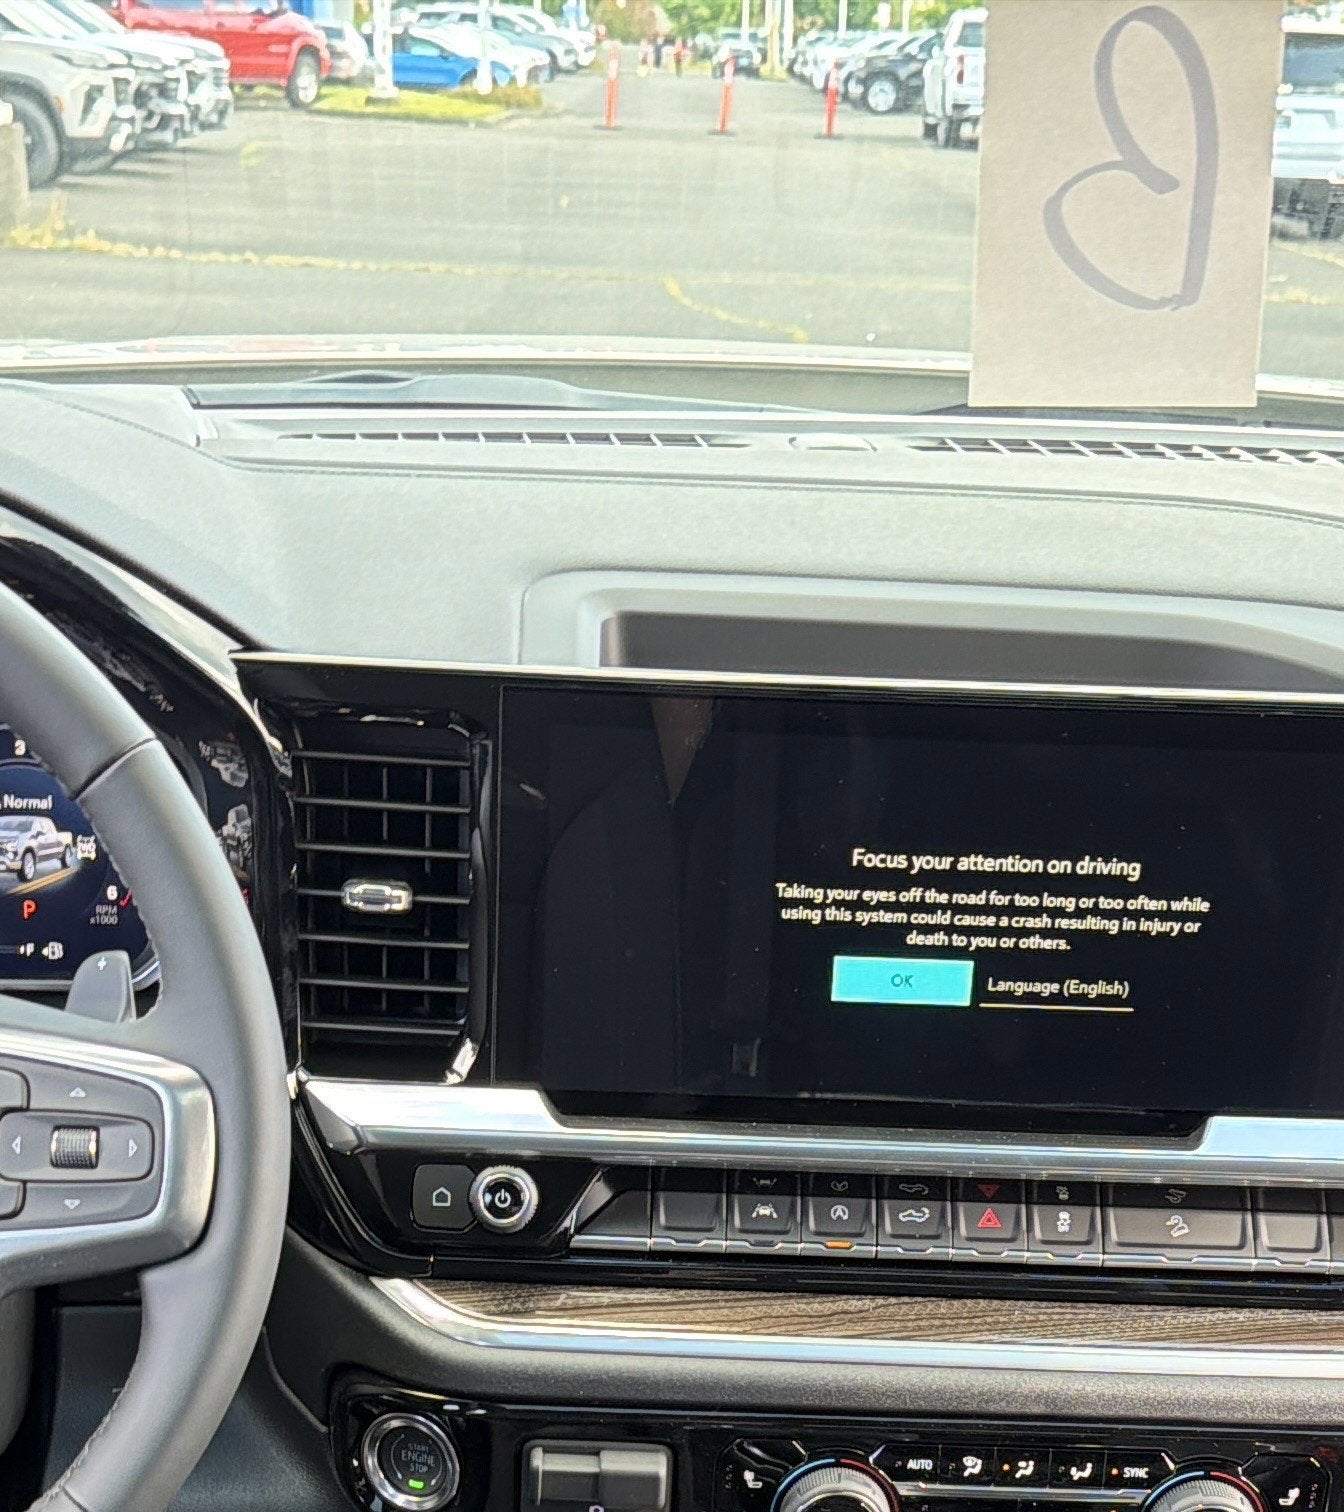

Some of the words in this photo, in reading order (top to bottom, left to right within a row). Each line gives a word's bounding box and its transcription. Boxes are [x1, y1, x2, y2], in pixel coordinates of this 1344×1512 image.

[15, 739, 26, 756] 3
[3, 794, 53, 811] Normal
[851, 848, 908, 869] Focus
[909, 854, 954, 874] your
[957, 854, 1044, 874] attention
[1047, 859, 1072, 875] on
[1076, 856, 1142, 882] driving
[775, 882, 824, 903] Taking
[826, 888, 859, 904] your
[862, 890, 896, 906] eyes
[899, 887, 923, 903] off
[924, 888, 949, 904] the
[952, 890, 986, 906] road
[988, 890, 1012, 906] for
[1014, 893, 1039, 907] too
[1043, 892, 1076, 912] long
[1079, 896, 1096, 909] or
[1098, 896, 1124, 909] too
[1126, 895, 1167, 911] often
[1170, 897, 1210, 913] while
[23, 900, 37, 919] P
[95, 904, 118, 916] RPM
[89, 915, 118, 925] x1000
[781, 906, 821, 924] using
[824, 906, 852, 922] this
[855, 910, 907, 926] system
[910, 910, 951, 925] could
[954, 913, 996, 927] cause
[999, 916, 1009, 928] a
[1011, 913, 1052, 928] crash
[1055, 915, 1120, 934] resulting
[1123, 917, 1136, 931] in
[1139, 917, 1182, 936] injury
[1183, 921, 1202, 933] or
[906, 930, 948, 946] death
[951, 932, 967, 947] to
[969, 936, 997, 951] you
[999, 937, 1017, 949] or
[1019, 934, 1072, 950] others.
[890, 974, 914, 988] OK
[987, 977, 1060, 997] Language
[1063, 979, 1130, 998] (English)
[408, 1443, 429, 1453] START
[401, 1450, 436, 1467] ENGINE
[907, 1459, 932, 1471] AUTO
[409, 1464, 428, 1474] STOP
[1123, 1466, 1149, 1479] SYNC
